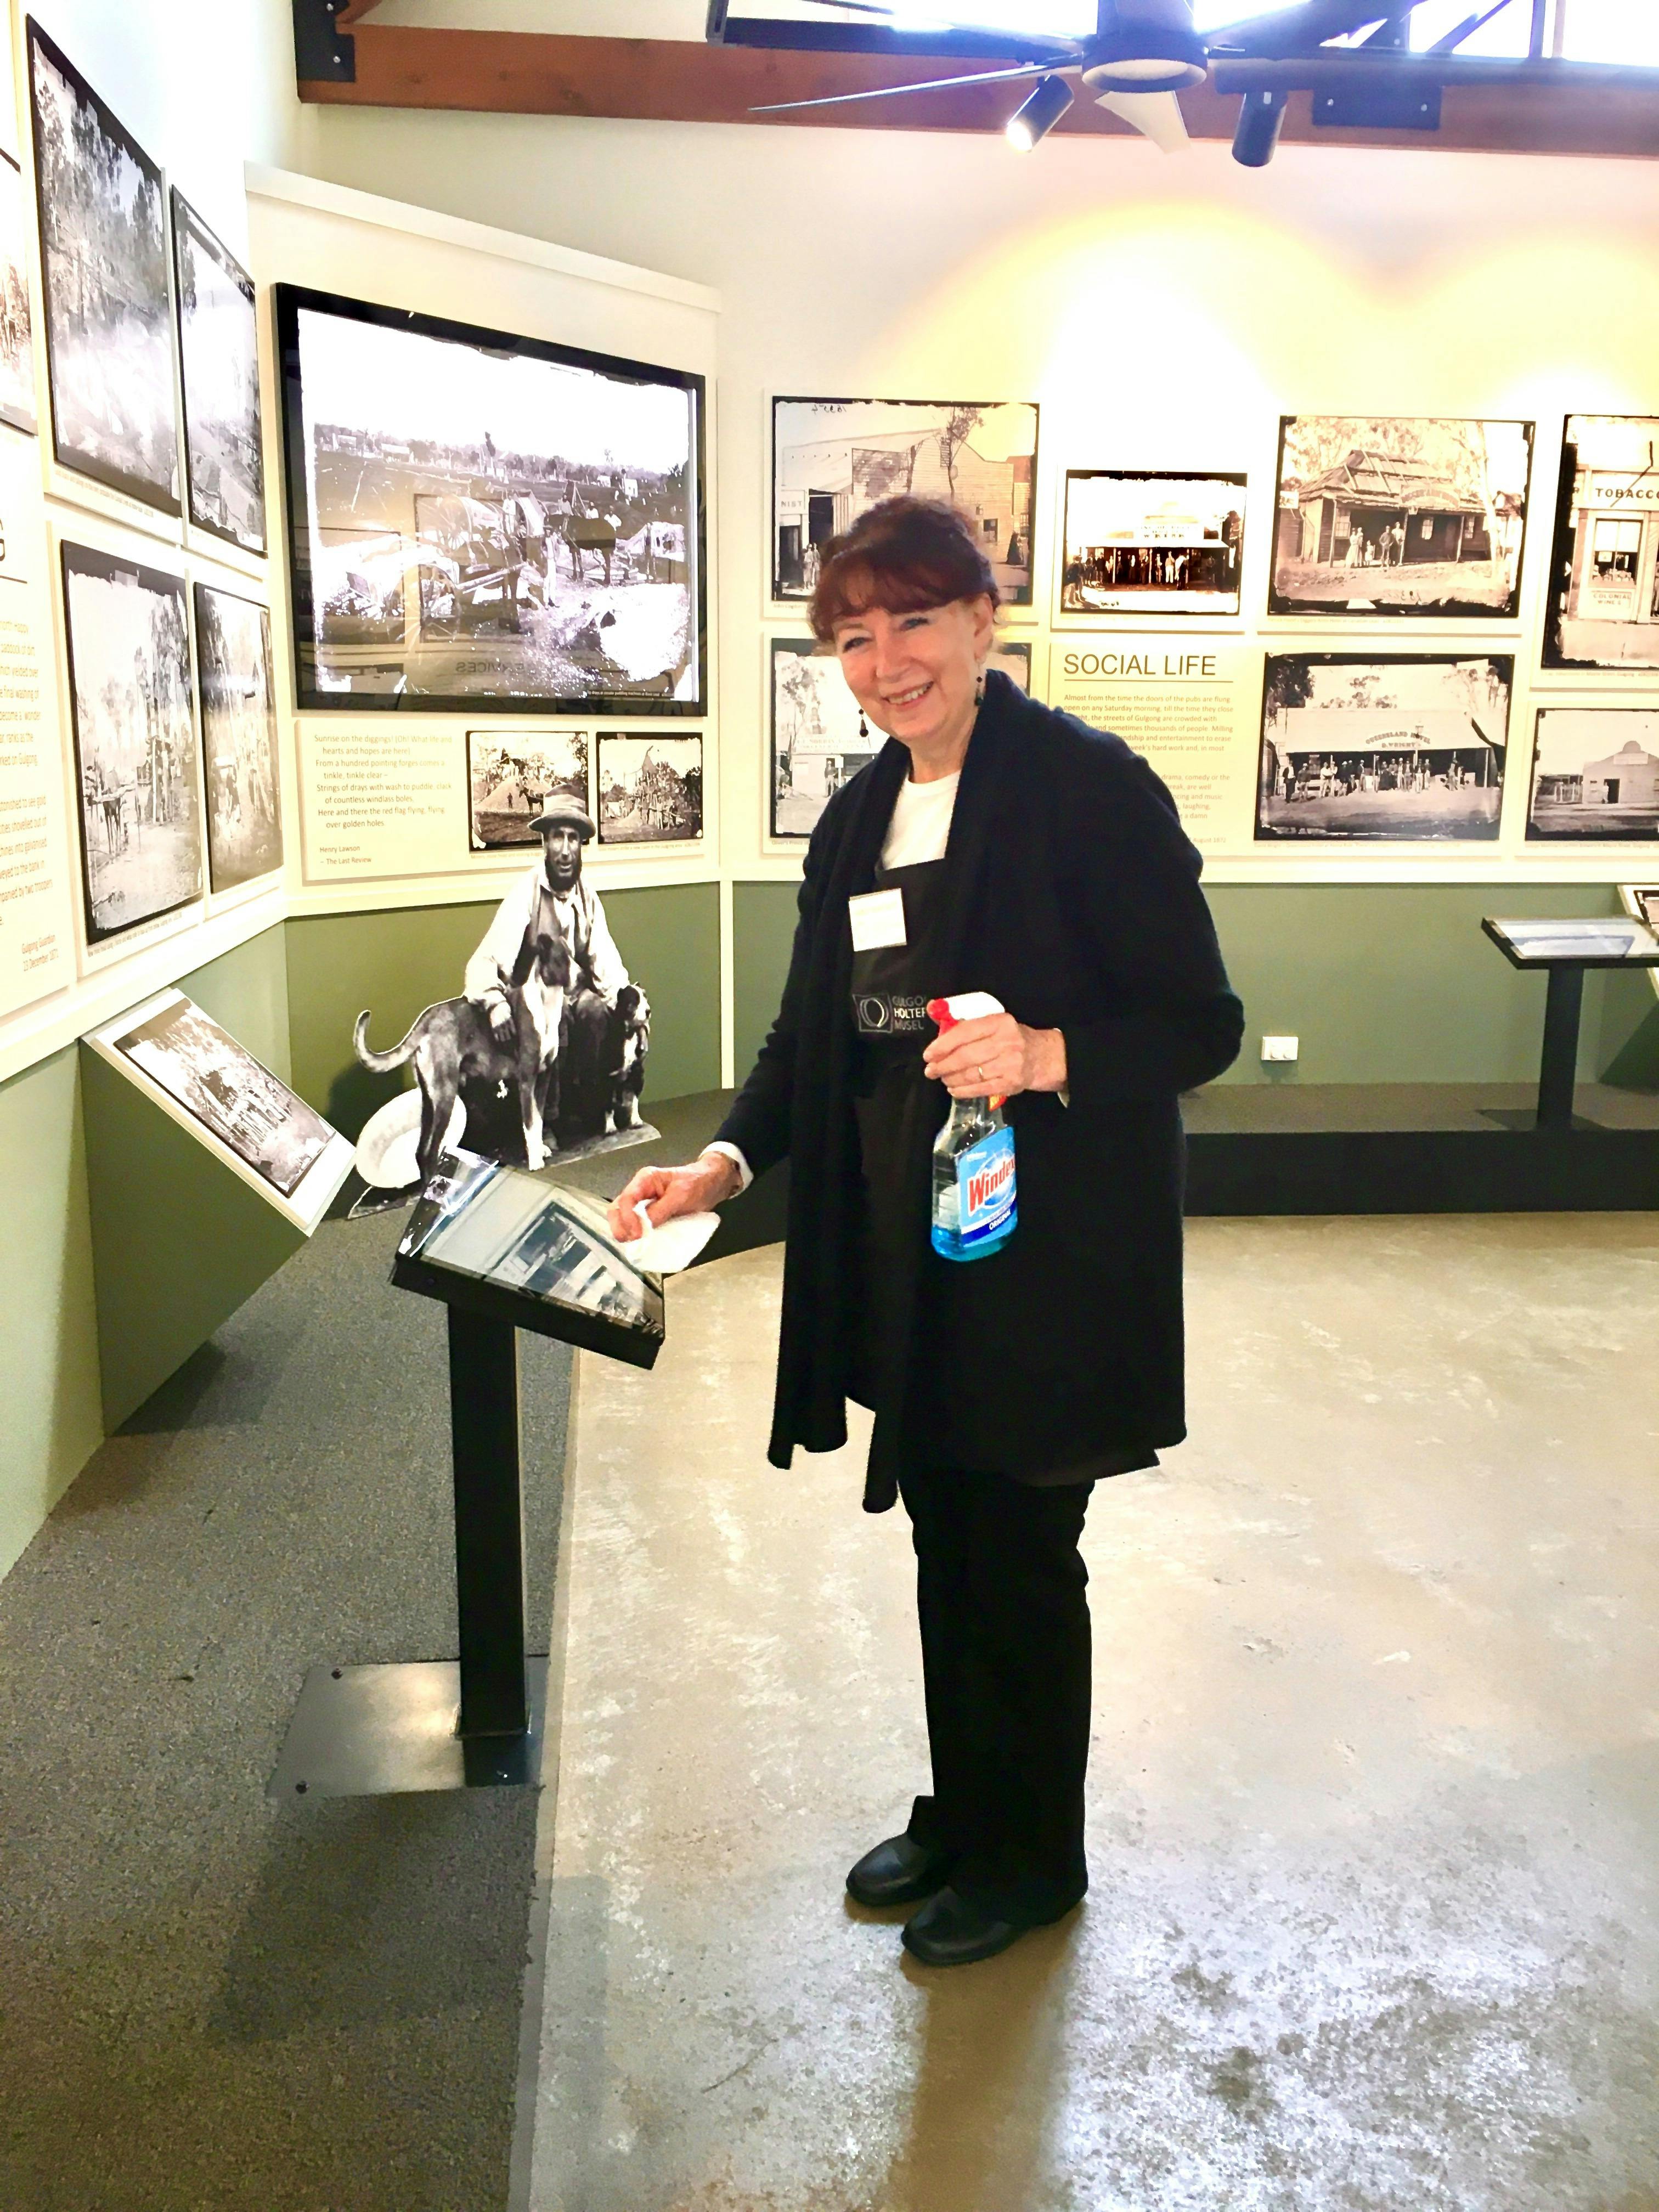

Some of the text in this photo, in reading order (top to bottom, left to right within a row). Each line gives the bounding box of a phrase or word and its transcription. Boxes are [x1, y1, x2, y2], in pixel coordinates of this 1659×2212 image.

[1064, 653, 1216, 675] SOCIAL LIFE
[1186, 696, 1201, 704] pubs
[1215, 696, 1230, 704] flung
[1104, 705, 1132, 714] Saturday
[1202, 706, 1216, 714] they
[1135, 714, 1160, 724] Gulgong
[322, 746, 345, 754] hearts
[345, 747, 359, 755] and
[359, 747, 380, 756] hopes
[399, 759, 418, 768] forges
[317, 784, 340, 793] Strings
[350, 783, 368, 792] drays
[335, 808, 349, 816] and
[394, 806, 407, 816] flag
[407, 806, 425, 815] flying,
[342, 820, 365, 830] golden
